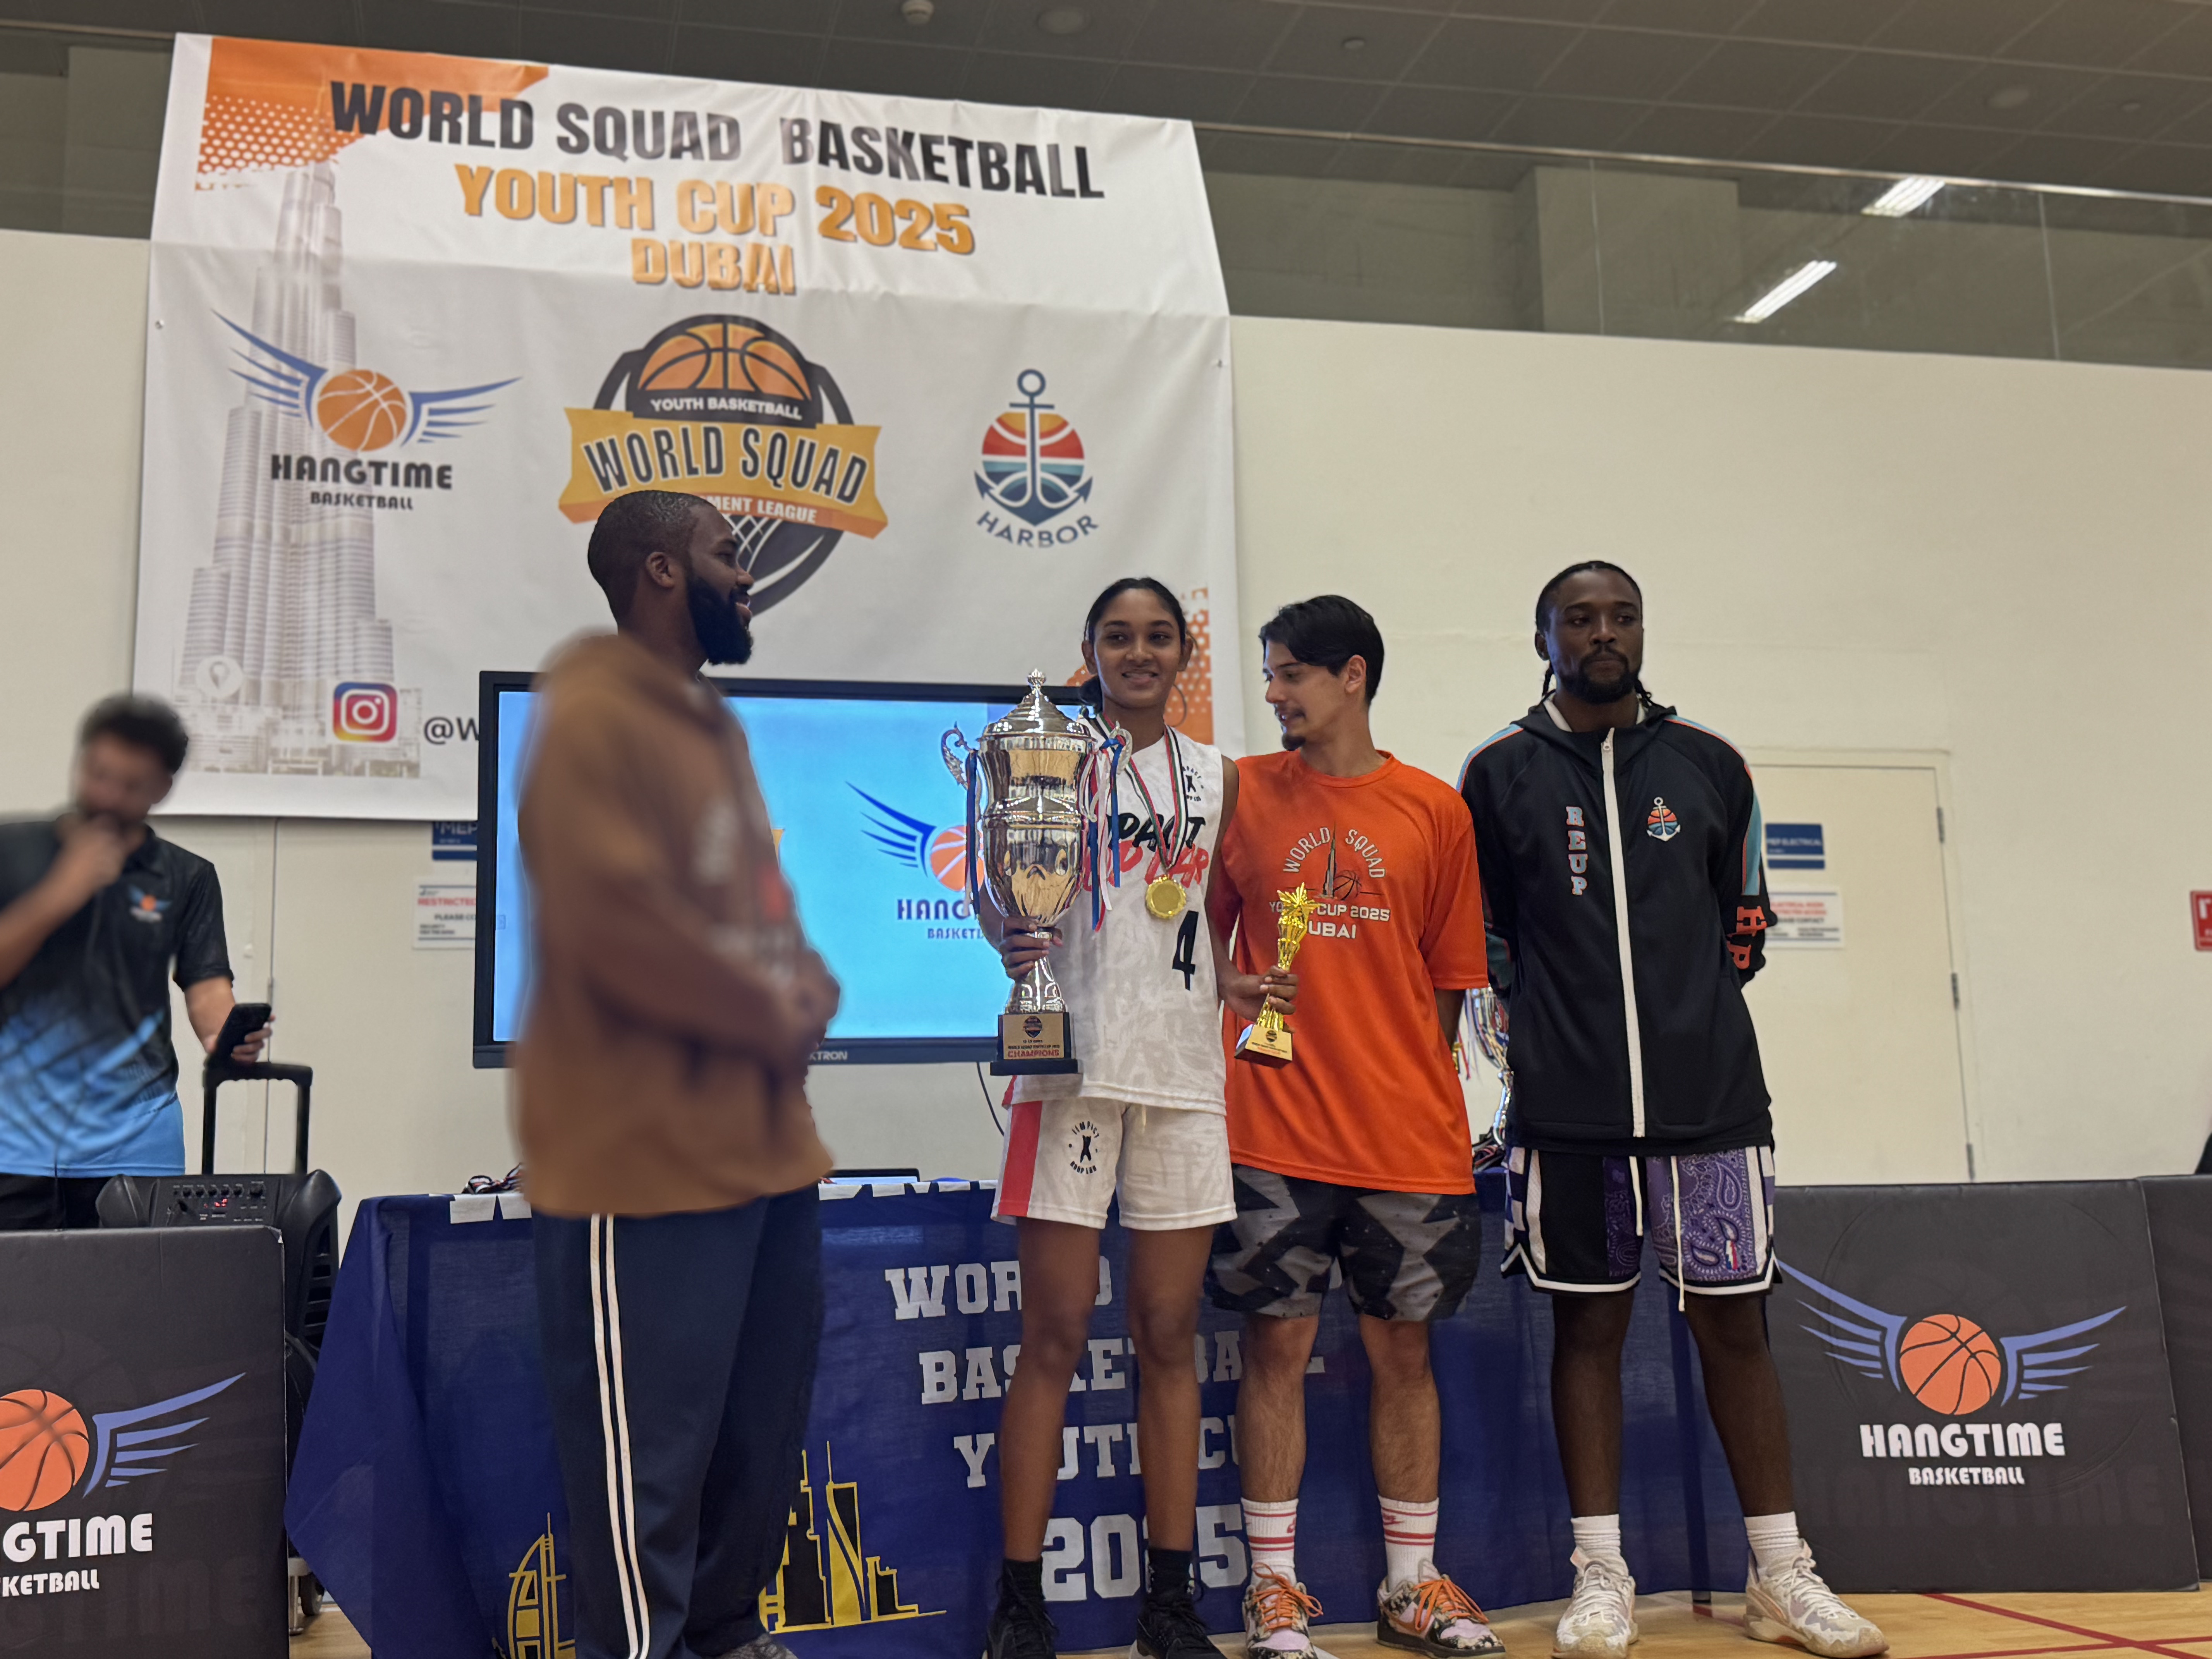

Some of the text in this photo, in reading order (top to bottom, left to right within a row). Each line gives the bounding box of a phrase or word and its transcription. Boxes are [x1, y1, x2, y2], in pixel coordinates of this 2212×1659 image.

[330, 81, 1105, 199] WORLD SQUAD BASKETBALL
[454, 163, 975, 256] YOUTH CUP 2025
[631, 238, 796, 296] DUBAI
[651, 397, 802, 421] YOUTH BASKETBALL
[271, 454, 453, 490] HANGTIME
[583, 426, 868, 504] WORLD SQUAD
[310, 491, 413, 510] BASKETBALL
[757, 499, 818, 524] LEAGUE
[976, 511, 1099, 549] HARBOR
[424, 717, 479, 745] @W
[1283, 827, 1385, 878] WORLD SQUAD
[1566, 806, 1587, 895] REUP
[897, 899, 977, 920] HANG
[1317, 903, 1347, 916] CUP
[1350, 905, 1391, 922] 2025
[1308, 921, 1356, 939] UBAI
[1172, 910, 1199, 991] 4
[810, 1050, 848, 1061] KTRON
[1860, 1422, 2066, 1458] HANGTIME
[1908, 1467, 2025, 1486] BASKETBALL
[3, 1513, 153, 1563] GTIME
[1042, 1503, 1249, 1601] 205
[0, 1569, 100, 1597] KETBALL
